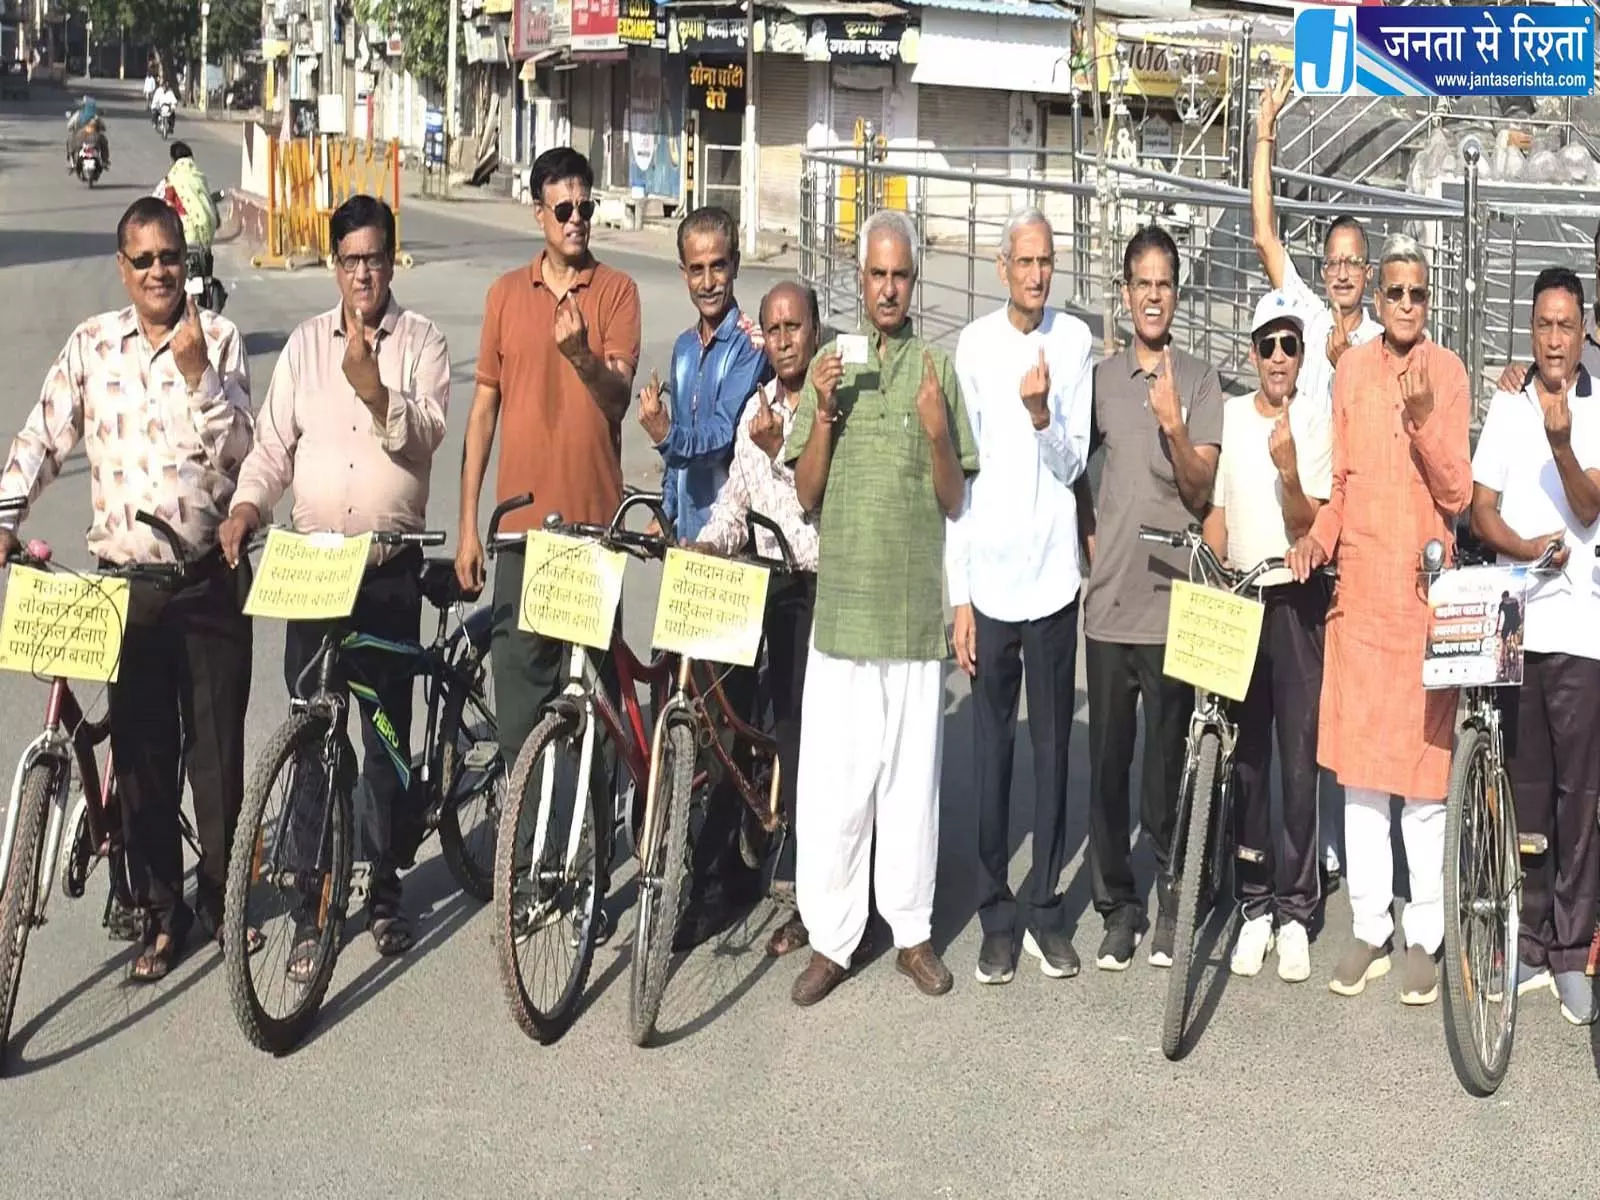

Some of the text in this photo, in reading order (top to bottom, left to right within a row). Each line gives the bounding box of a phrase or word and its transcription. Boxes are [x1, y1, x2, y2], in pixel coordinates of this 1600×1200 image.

[617, 18, 656, 39] EXCHANGE
[685, 560, 724, 580] मतदान
[372, 706, 400, 749] HERO
